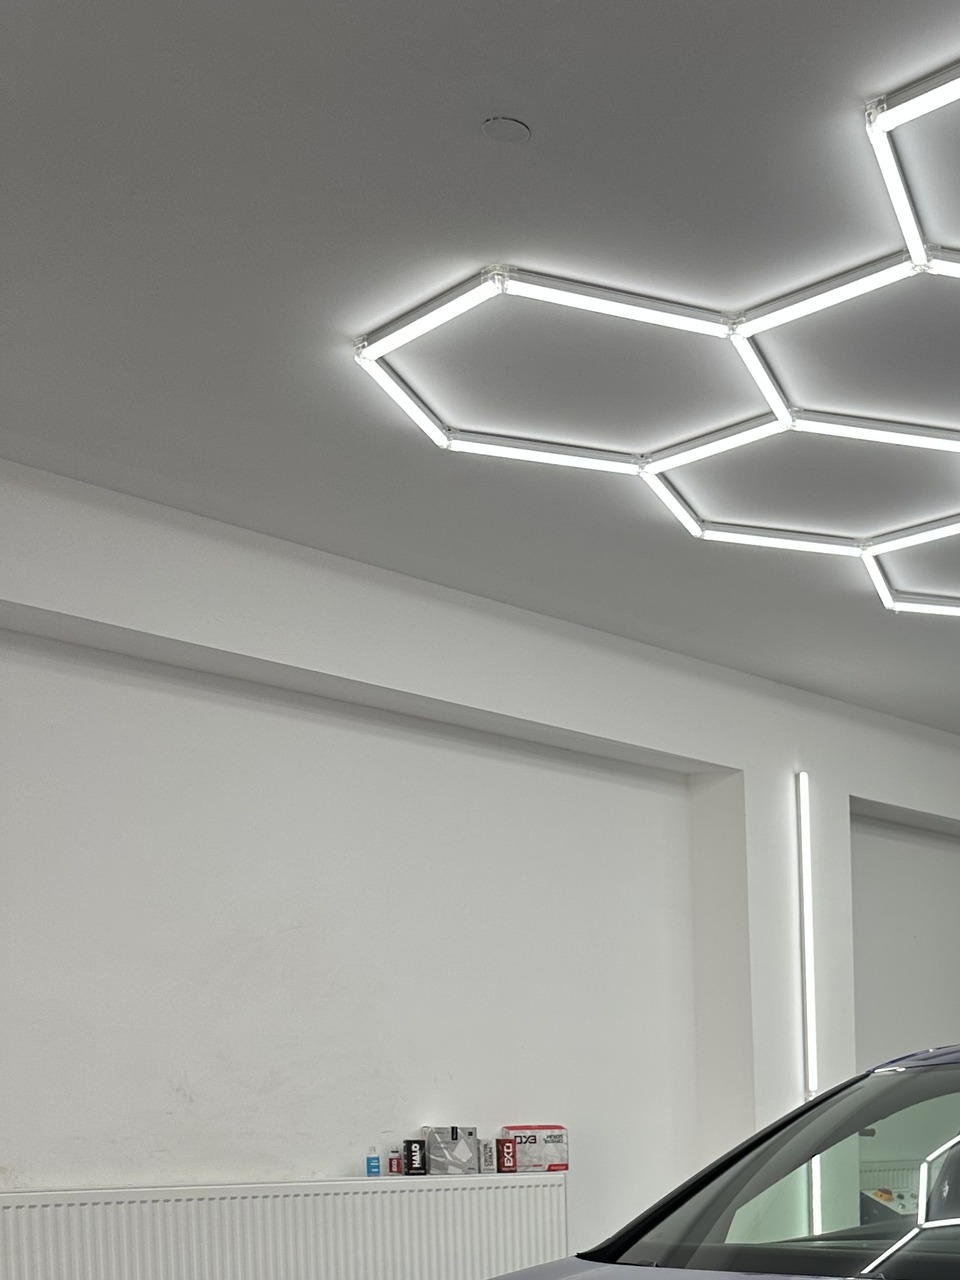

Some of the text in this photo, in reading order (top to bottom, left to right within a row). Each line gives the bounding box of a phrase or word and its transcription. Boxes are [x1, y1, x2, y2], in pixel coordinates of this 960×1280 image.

[514, 1135, 537, 1144] EXO
[412, 1143, 420, 1167] HALO
[504, 1143, 513, 1167] EXO
